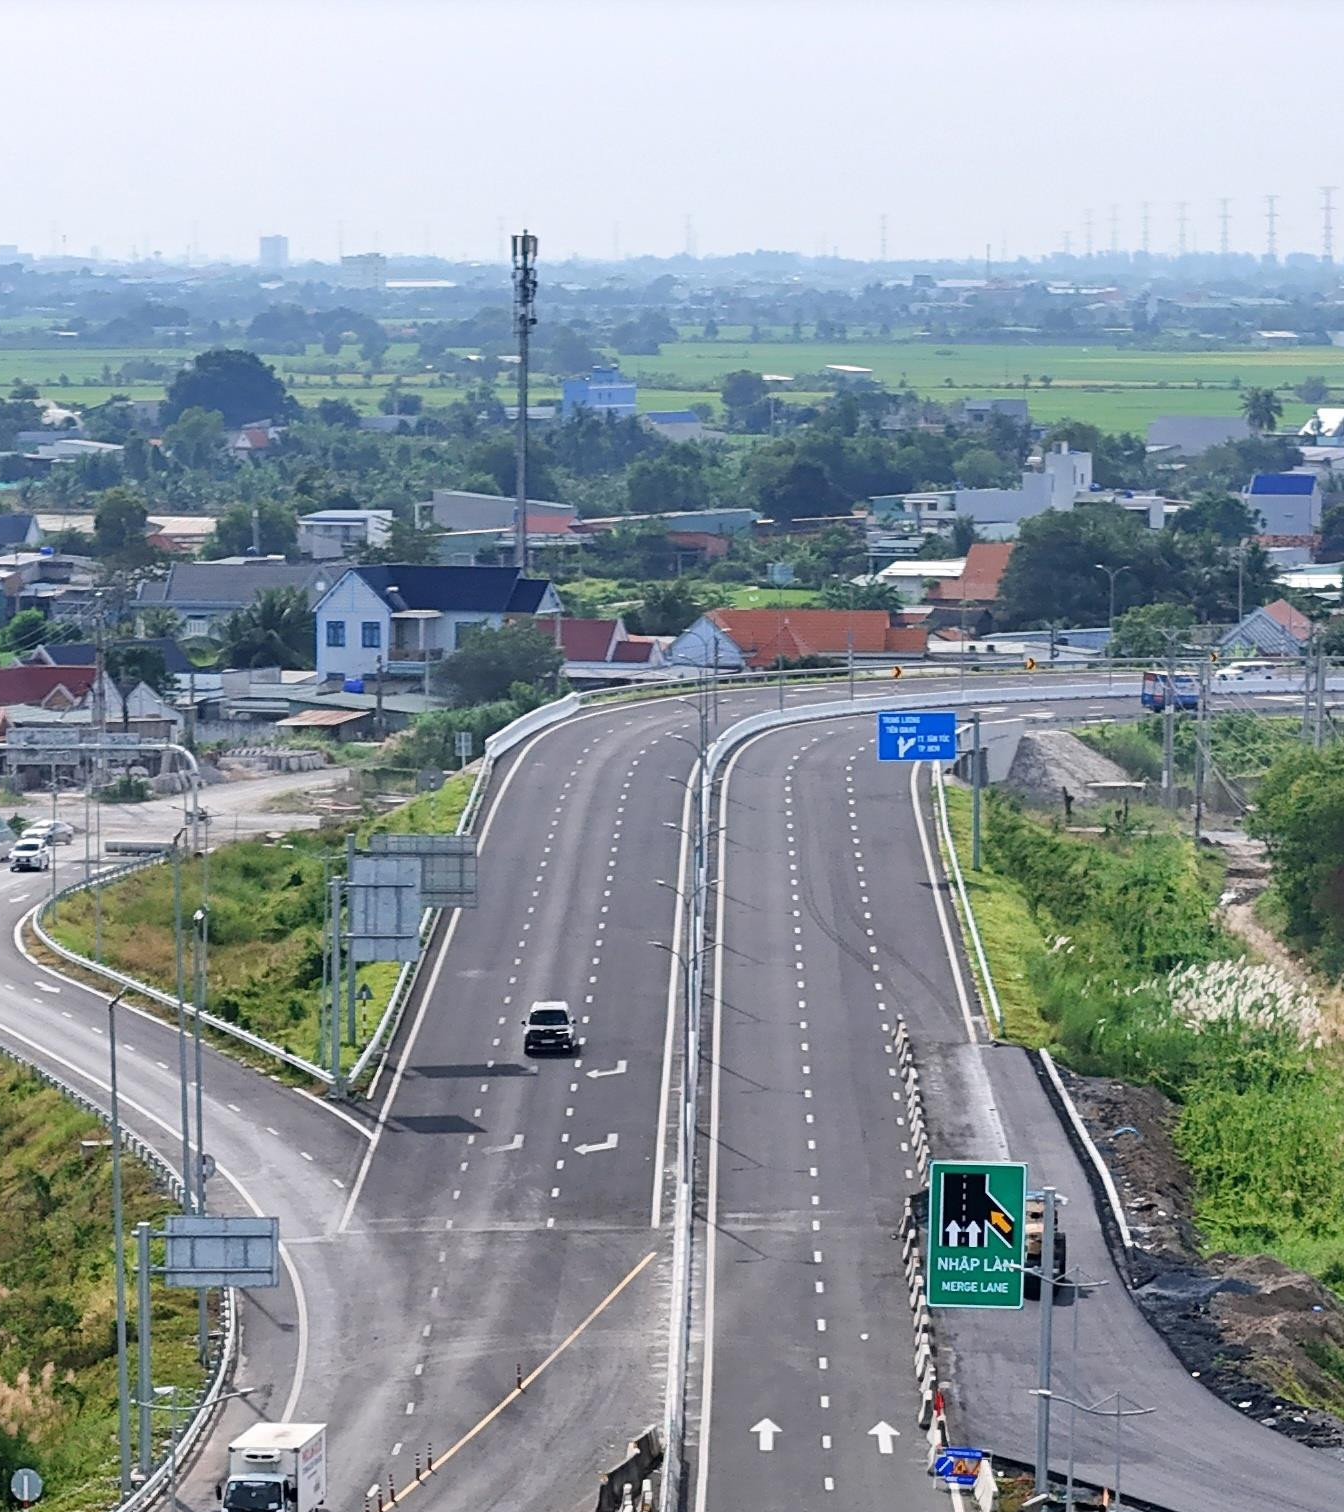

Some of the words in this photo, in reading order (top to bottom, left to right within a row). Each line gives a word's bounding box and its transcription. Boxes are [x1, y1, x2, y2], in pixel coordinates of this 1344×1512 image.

[937, 1255, 980, 1274] NHẬP
[983, 1255, 1015, 1273] LÀN
[941, 1281, 978, 1292] MERGE
[980, 1282, 1009, 1293] LANE
